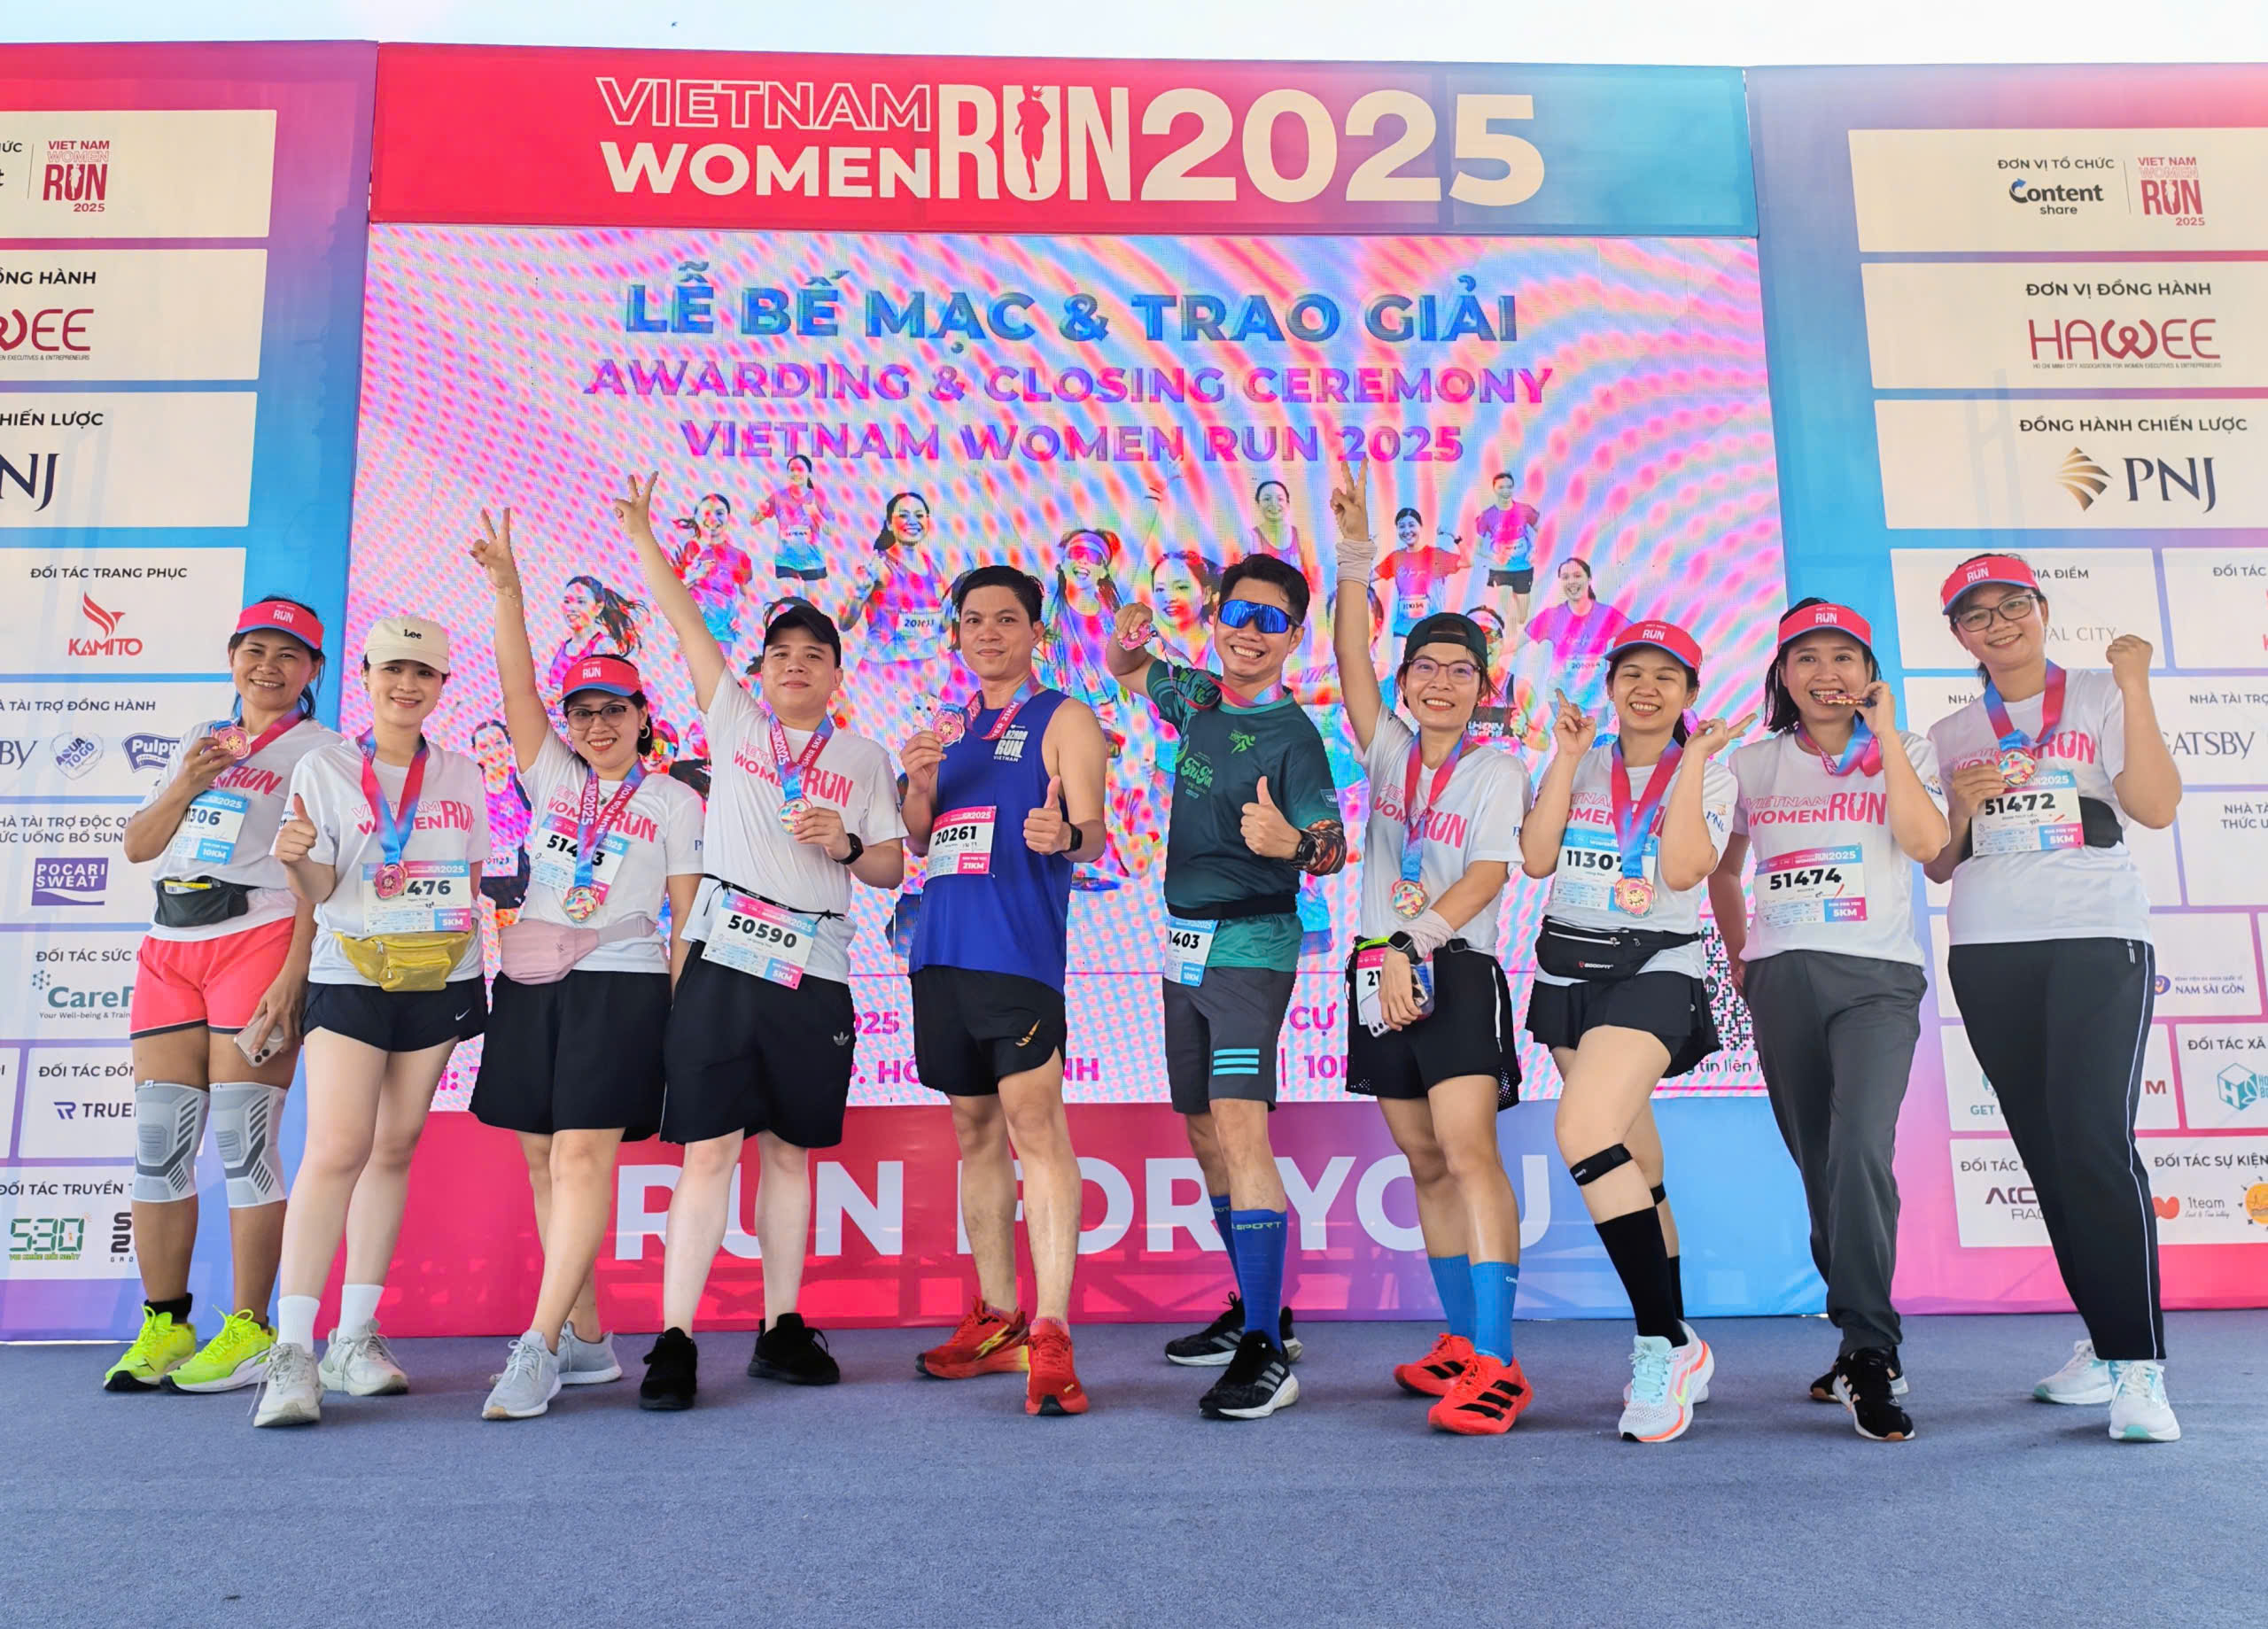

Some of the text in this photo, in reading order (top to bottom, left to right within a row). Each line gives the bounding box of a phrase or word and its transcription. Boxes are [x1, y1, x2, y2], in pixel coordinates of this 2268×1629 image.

[595, 76, 931, 131] VIETNAM
[0, 141, 22, 152] ỨC
[48, 141, 110, 150] VIET NAM
[937, 83, 1546, 207] RUN 2025
[47, 151, 110, 163] WOMEN
[1998, 159, 2030, 169] ĐƠN
[2075, 157, 2115, 169] CHỨC
[2138, 157, 2196, 166] VIET NAM
[600, 141, 931, 199] WOMEN
[43, 163, 108, 201] RUN
[2008, 178, 2104, 204] Content
[2140, 179, 2203, 215] RUN
[74, 203, 105, 213] 2025
[2039, 205, 2078, 214] share
[2175, 217, 2205, 226] 2025
[40, 268, 97, 284] HÀNH
[2026, 282, 2068, 296] ĐƠN
[2096, 279, 2152, 296] ĐỒNG
[2157, 280, 2211, 296] HÀNH
[626, 260, 1517, 353] LỄ BẾ MẠC & TRAO GIẢI
[2028, 318, 2220, 360] HAWEE
[584, 358, 1554, 404] AWARDING & CLOSING CEREMONY
[51, 411, 104, 429] LƯỢC
[2019, 415, 2248, 434] ĐỒNG HÀNH CHIẾN LƯỢC
[680, 418, 1464, 462] VIETNAM WOMEN RUN 2025
[2122, 457, 2216, 514] PNJ
[30, 564, 188, 580] ĐỐI TÁC TRANG PHỤC
[1966, 569, 1989, 582] RUN
[2213, 563, 2266, 577] ĐỐI TÁC
[274, 609, 293, 624] RUN
[1815, 613, 1837, 624] RUN
[404, 628, 422, 640] Lee
[1643, 629, 1665, 640] RUN
[2076, 626, 2117, 641] CITY
[68, 638, 143, 655] KAMITO
[582, 666, 601, 679] RUN
[9, 699, 31, 710] TÀI
[36, 700, 64, 713] TRỢ
[67, 697, 110, 711] ĐỒNG
[114, 698, 156, 710] HÀNH
[2190, 692, 2241, 704] NHÀ TÀI
[2039, 730, 2104, 764] RUN
[228, 765, 284, 795] RUN
[802, 766, 854, 809] RUN
[2042, 775, 2070, 785] 2025
[1746, 795, 1829, 809] VIETNAM
[1828, 791, 1887, 826] RUN
[1984, 793, 2056, 815] 51472
[2224, 803, 2253, 814] NHÀ
[21, 815, 43, 827] TÀI
[47, 815, 76, 830] TRỢ
[80, 815, 112, 830] ĐỘC
[1749, 808, 1827, 826] WOMEN
[2220, 817, 2257, 829] THỨC
[23, 829, 65, 842] UỐNG
[94, 832, 123, 842] SUN
[935, 826, 977, 846] 20261
[2050, 834, 2074, 844] 5KM
[1829, 850, 1856, 861] 2025
[36, 864, 105, 875] POCARI
[440, 865, 465, 874] 2025
[35, 876, 98, 888] SWEAT
[1769, 867, 1842, 890] 51474
[1833, 908, 1858, 917] 5KM
[727, 914, 797, 949] 50590
[35, 948, 132, 962] ĐỐI TÁC SỨC
[2176, 981, 2245, 994] NAM SÀI GÒN
[59, 1012, 101, 1020] Well-being
[2187, 1036, 2213, 1050] ĐỐI
[2217, 1036, 2244, 1050] TÁC
[38, 1062, 101, 1077] ĐỐI TÁC
[1970, 1105, 1995, 1115] GET
[1961, 1157, 2018, 1172] ĐỐI TÁC
[2155, 1152, 2179, 1167] ĐỐI
[2183, 1152, 2210, 1167] TÁC
[2214, 1154, 2233, 1169] SỰ
[29, 1181, 60, 1196] TÁC
[63, 1179, 119, 1195] TRUYỀN
[9, 1218, 85, 1252] 5:30
